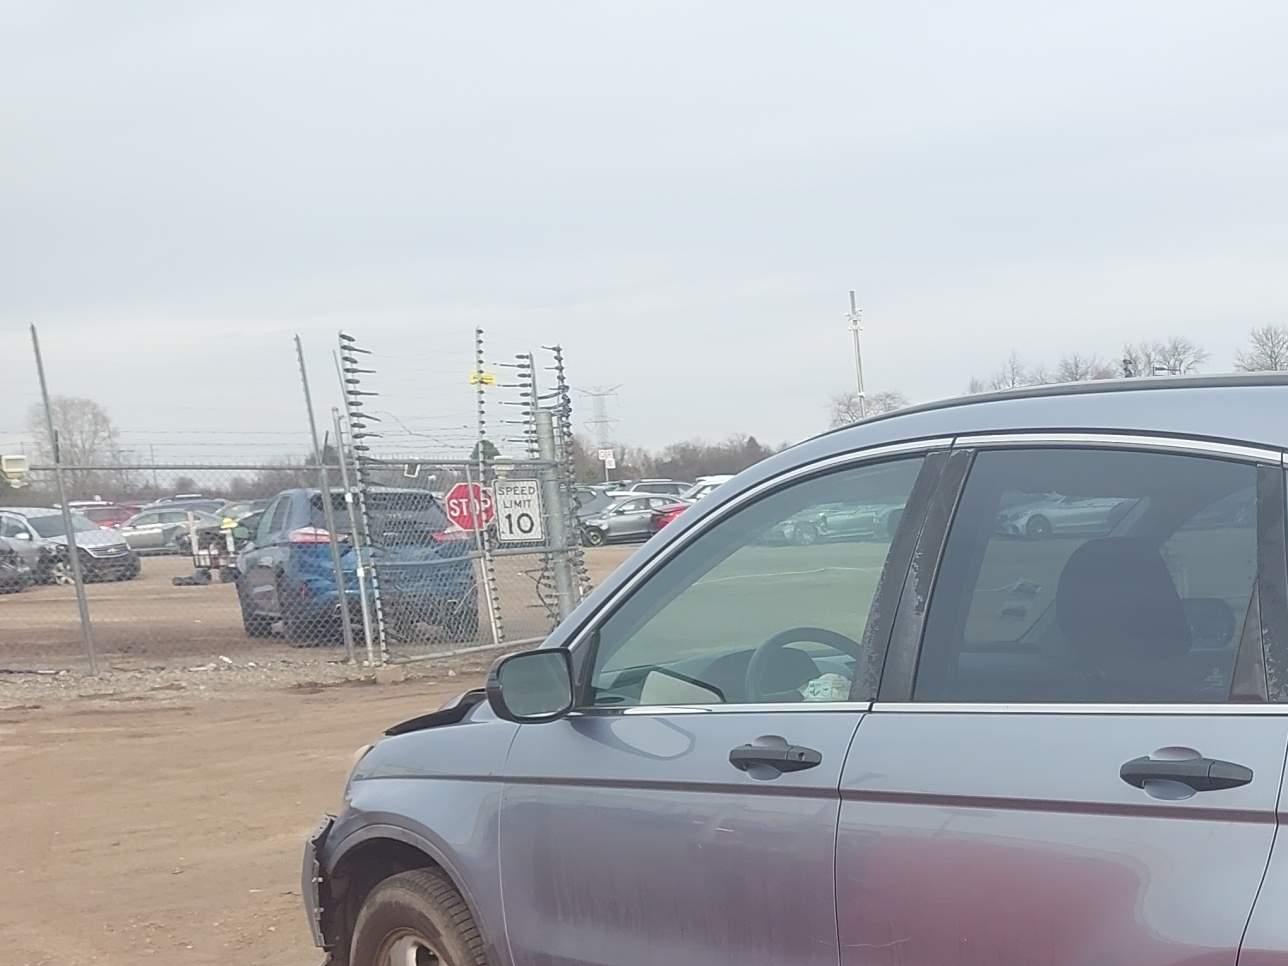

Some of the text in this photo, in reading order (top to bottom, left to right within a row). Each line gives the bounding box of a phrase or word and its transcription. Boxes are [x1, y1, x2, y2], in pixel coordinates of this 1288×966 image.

[498, 486, 536, 496] SPEED
[503, 499, 532, 509] LIMIT
[505, 512, 535, 534] 10
